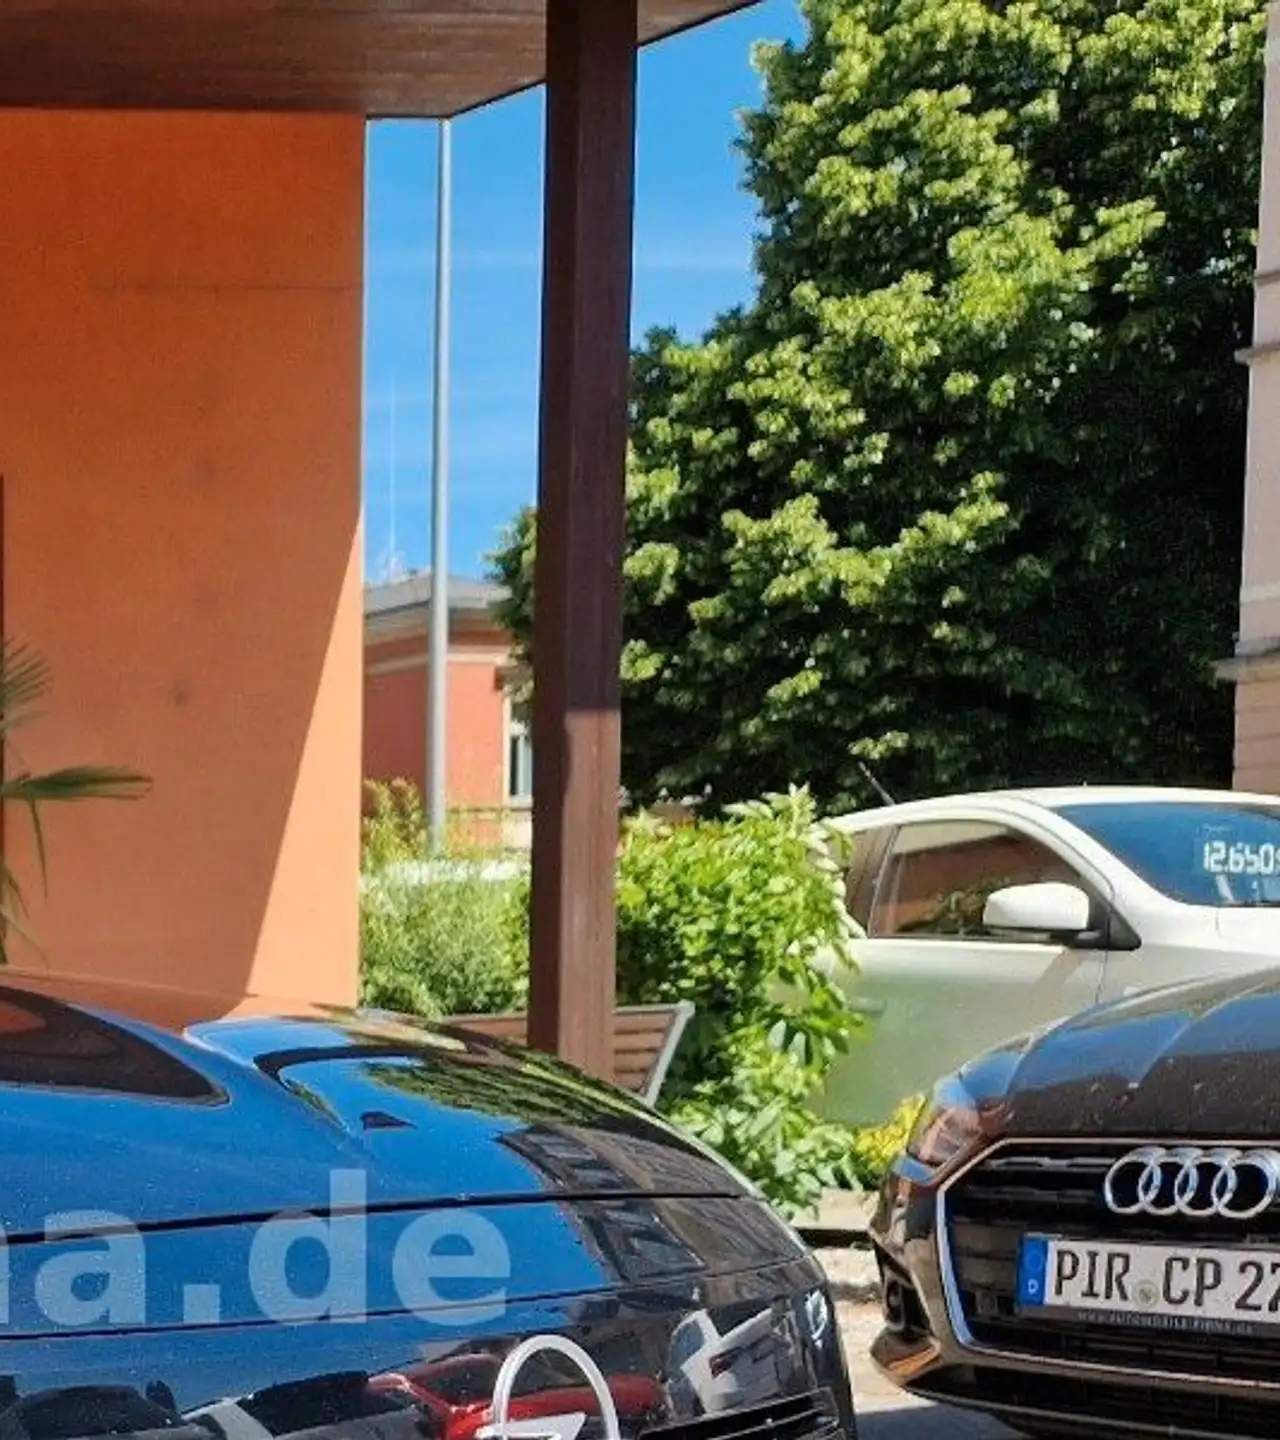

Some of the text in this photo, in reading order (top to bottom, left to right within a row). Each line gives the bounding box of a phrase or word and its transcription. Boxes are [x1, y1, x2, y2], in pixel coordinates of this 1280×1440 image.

[1203, 839, 1280, 876] 12.650
[1054, 1248, 1131, 1302] PIR
[1162, 1255, 1223, 1307] CP
